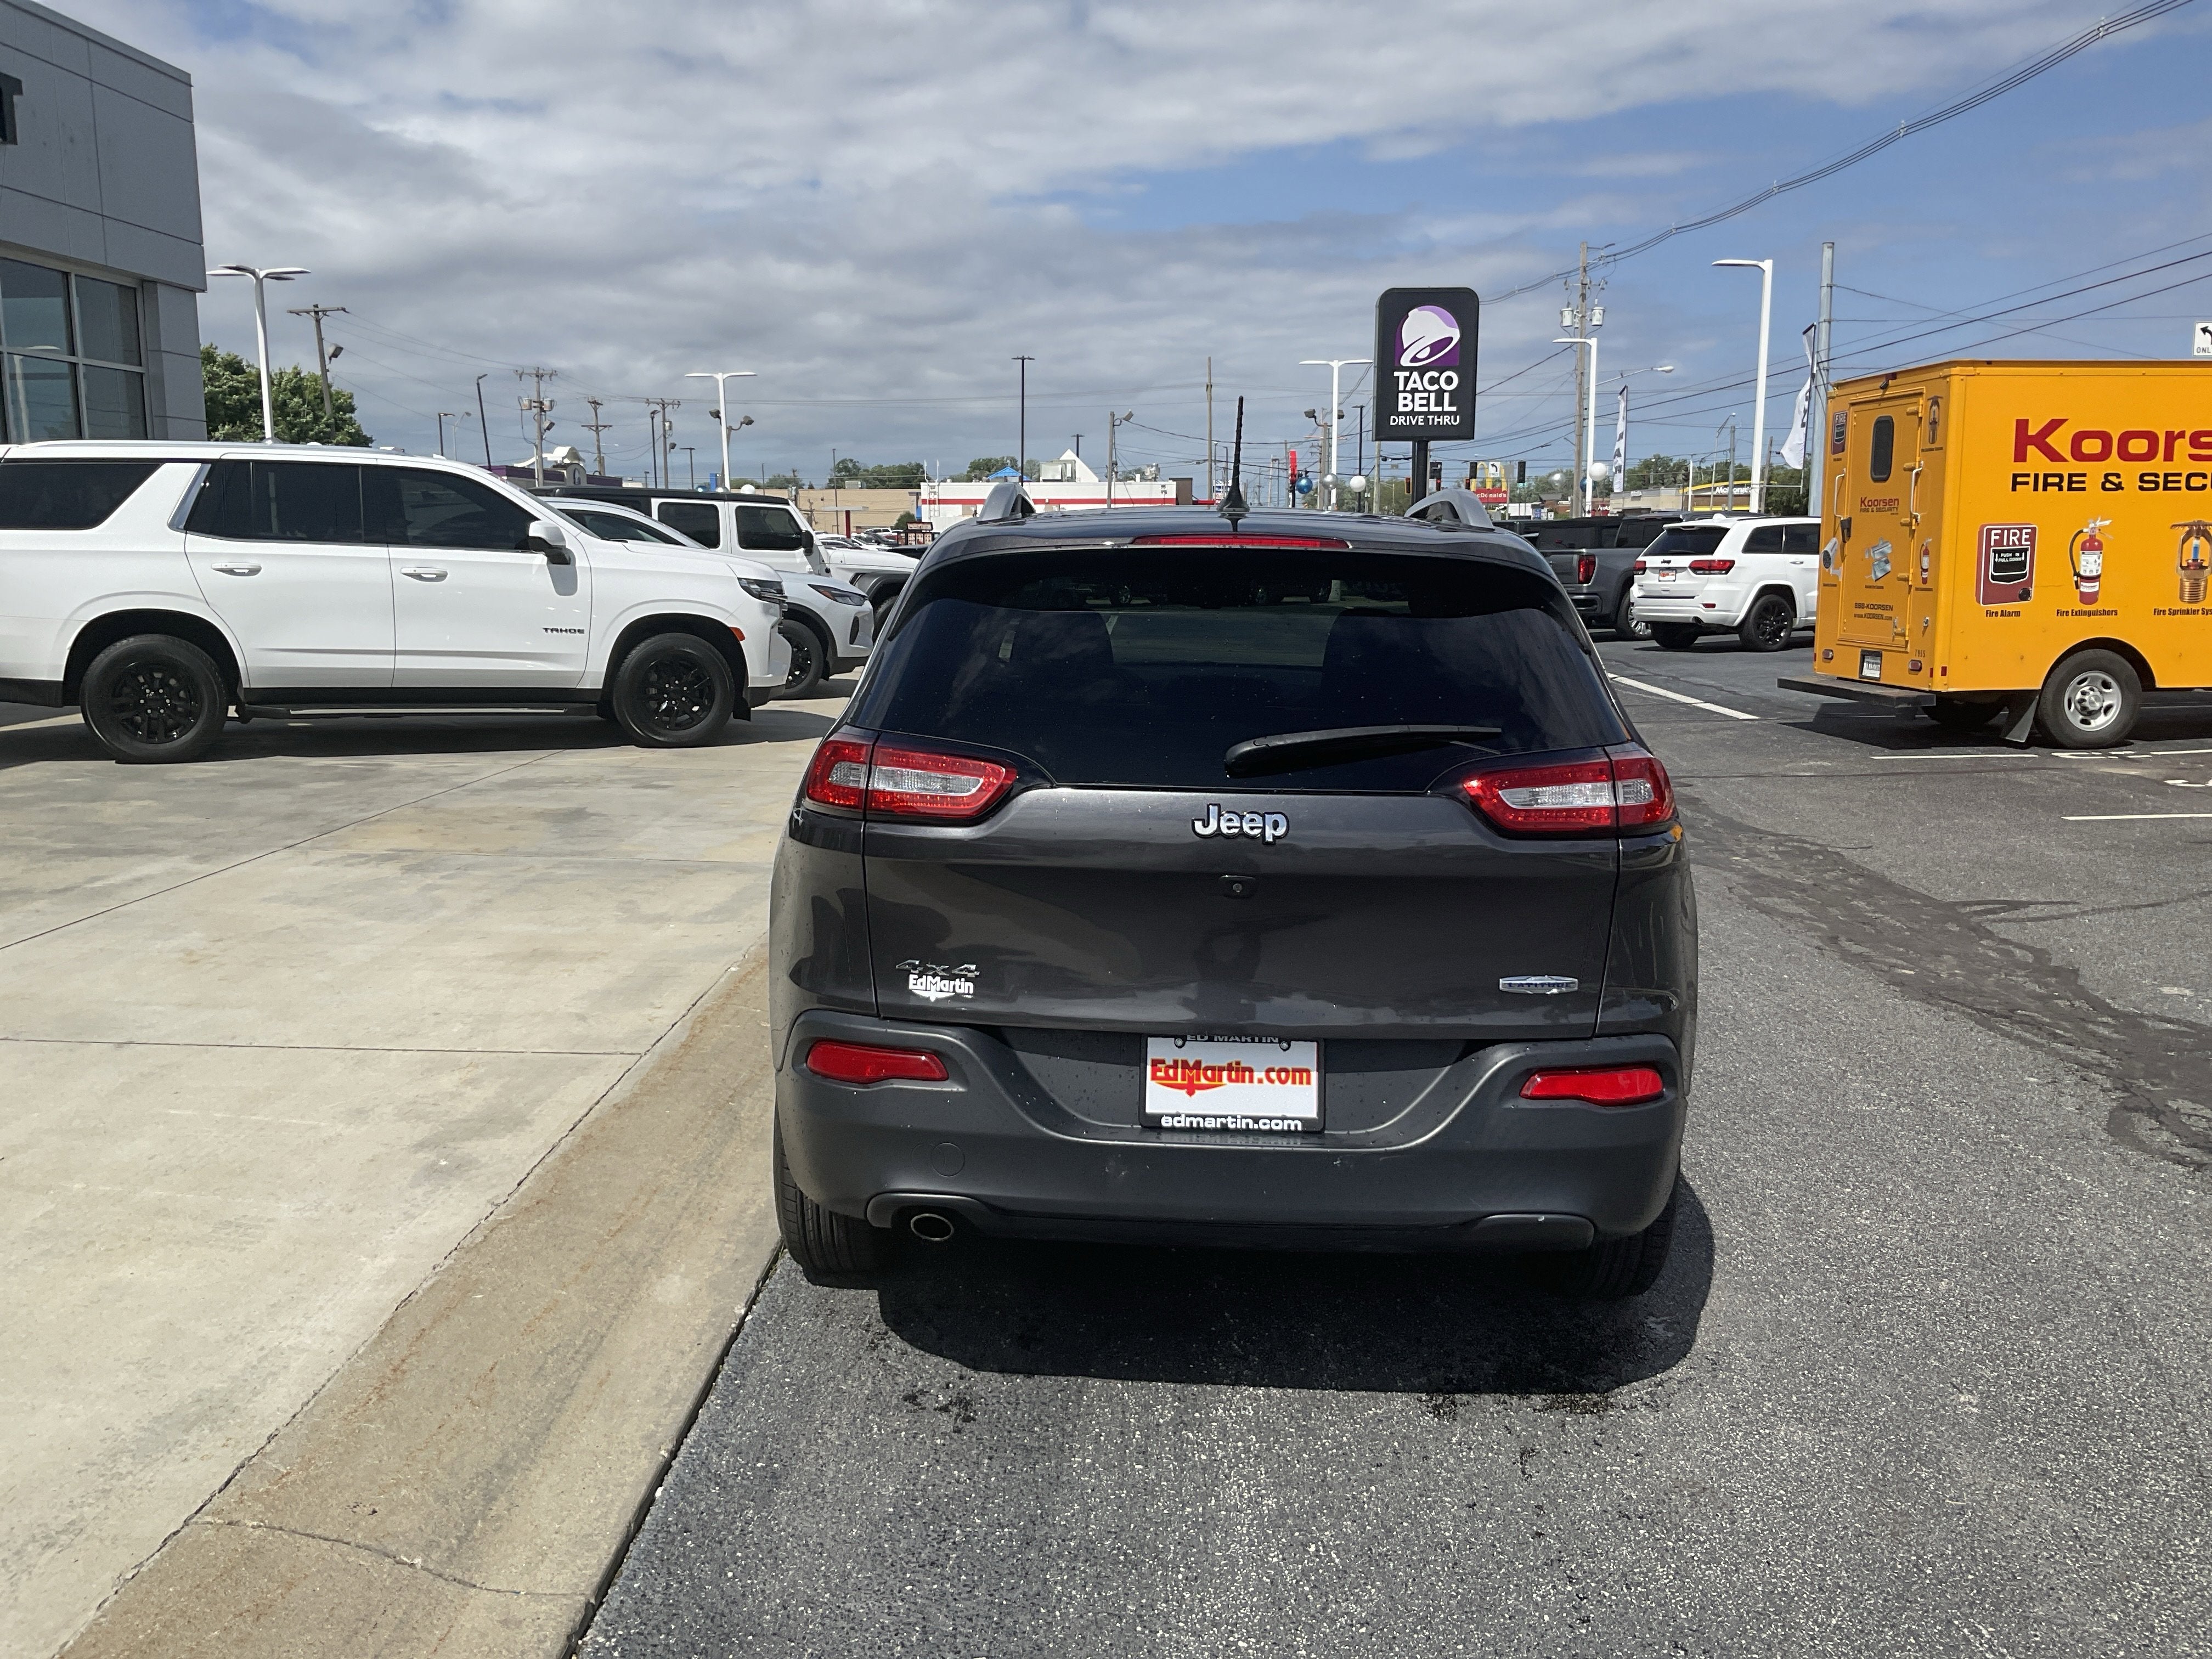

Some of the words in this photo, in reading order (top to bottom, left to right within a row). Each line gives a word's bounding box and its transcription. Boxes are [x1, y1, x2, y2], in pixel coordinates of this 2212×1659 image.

[1393, 371, 1458, 391] TACO
[1397, 392, 1457, 411] BELL
[1390, 415, 1424, 425] DRIVE
[1427, 415, 1460, 425] THRU
[1835, 413, 1847, 423] FIRE
[2013, 419, 2212, 462] Koors
[2011, 472, 2087, 492] FIRE
[2101, 472, 2124, 492] &
[2138, 472, 2212, 492] SEC
[1860, 496, 1899, 507] Koorsen
[1990, 529, 2031, 546] FIRE
[2071, 608, 2118, 617] Extinguishers
[2168, 607, 2200, 616] Sprinkler
[1192, 803, 1289, 845] Jeep
[896, 959, 980, 978] 4x4
[908, 974, 974, 994] EdMartin
[1214, 1035, 1279, 1043] MARTIN
[1150, 1058, 1312, 1085] EdMartin.com
[1161, 1113, 1302, 1131] edmartin.com
